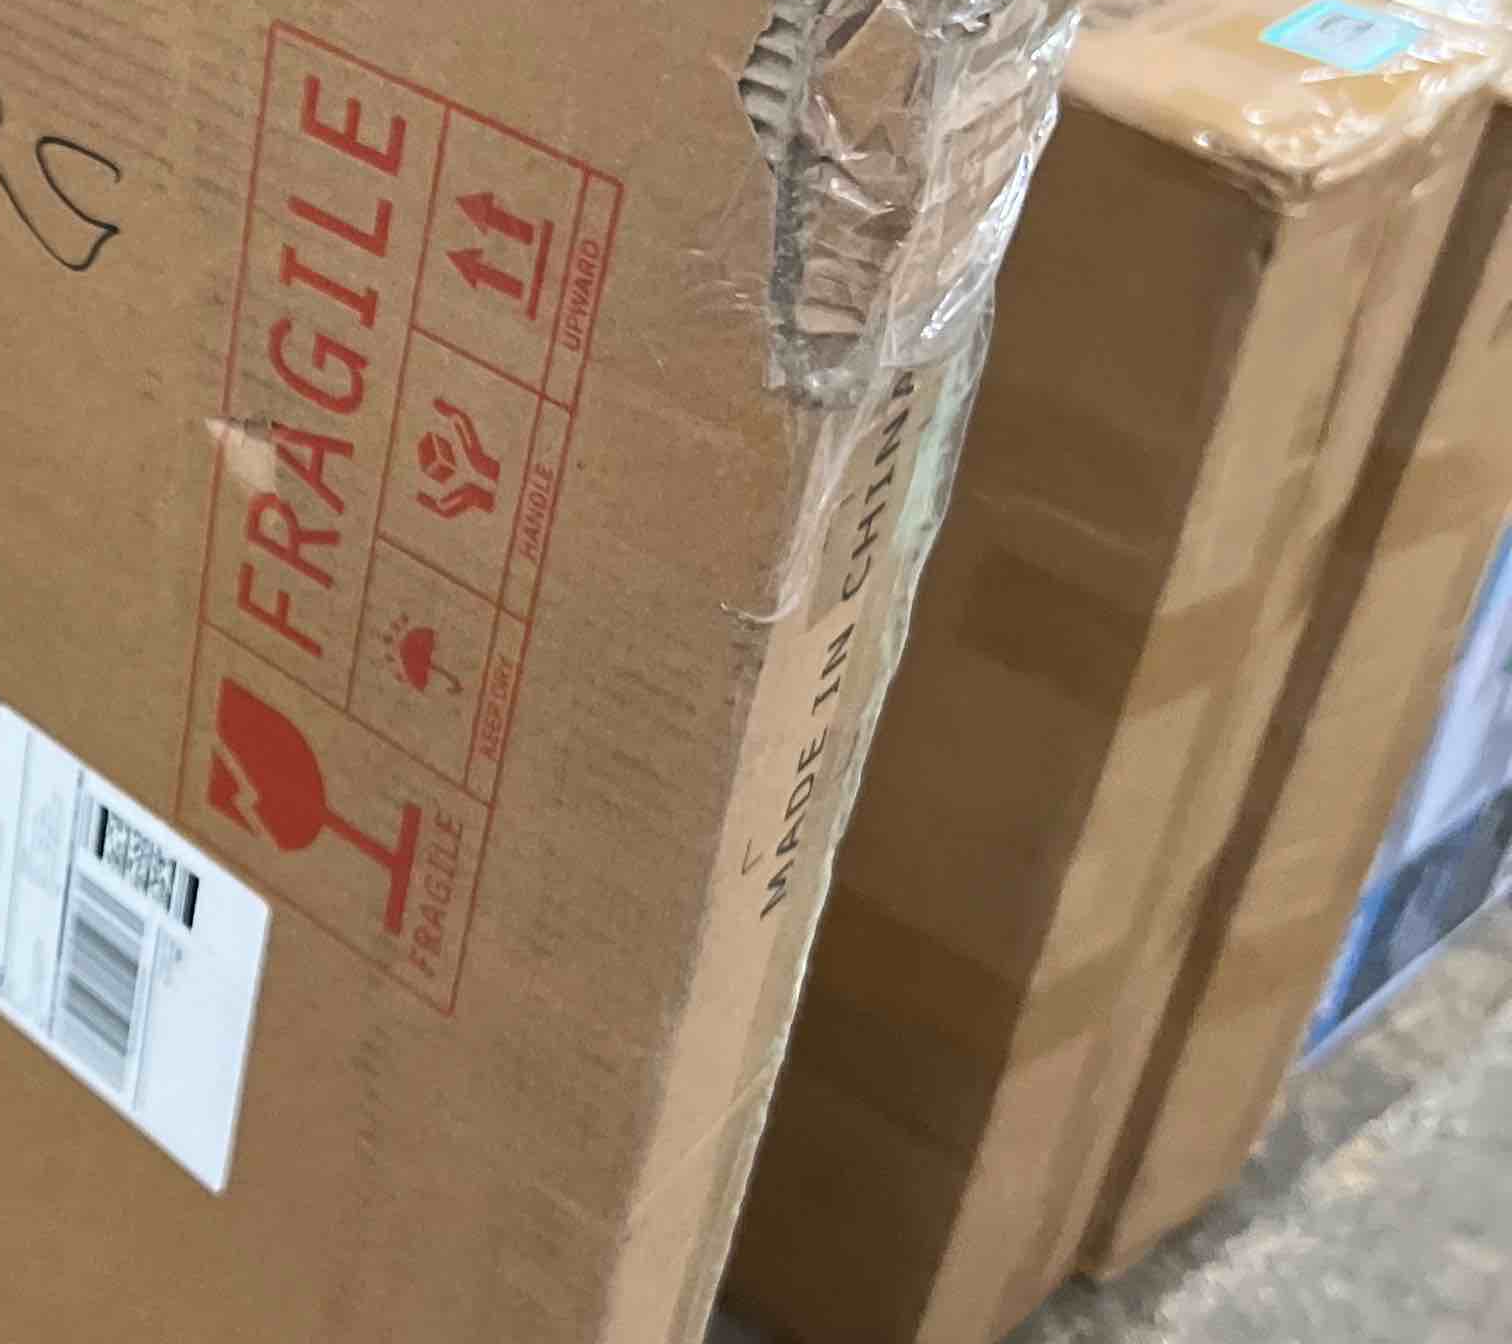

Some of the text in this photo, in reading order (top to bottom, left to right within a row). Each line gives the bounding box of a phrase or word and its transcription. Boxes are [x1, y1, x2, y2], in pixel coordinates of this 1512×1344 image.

[241, 74, 408, 657] FRAGILE
[564, 237, 601, 355] UPWARD
[519, 459, 556, 560] HANDLE
[759, 370, 915, 919] MADE IN CHINA
[406, 810, 465, 982] FRAGILE
